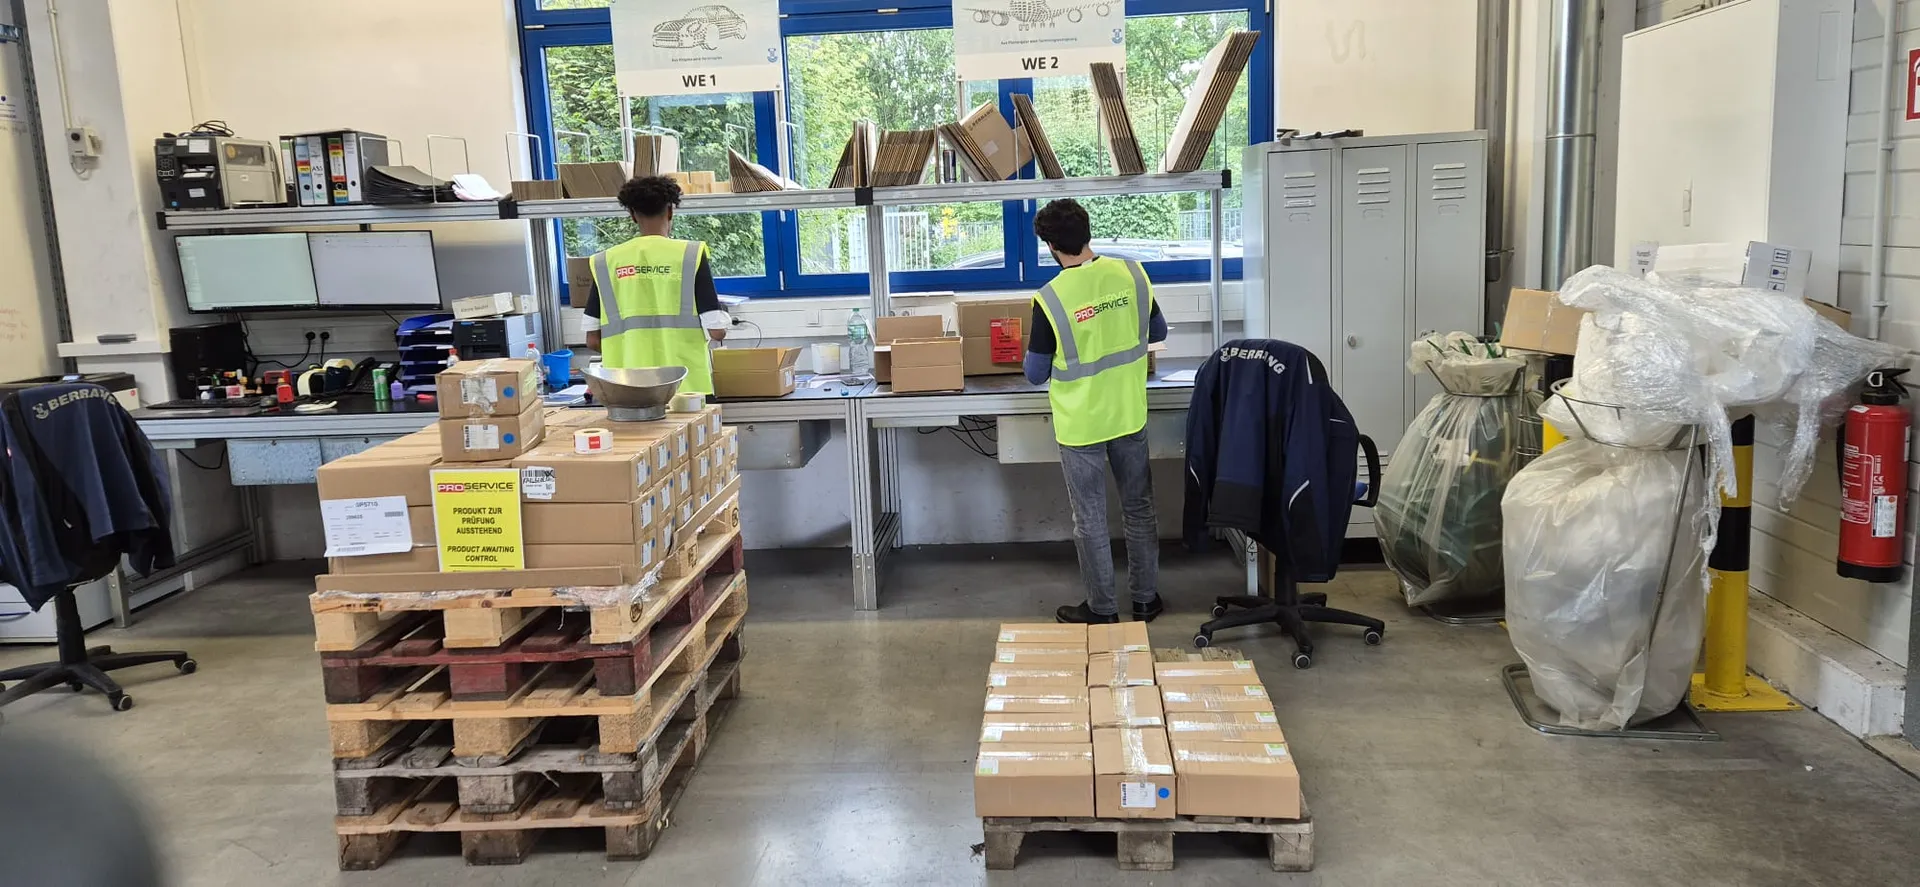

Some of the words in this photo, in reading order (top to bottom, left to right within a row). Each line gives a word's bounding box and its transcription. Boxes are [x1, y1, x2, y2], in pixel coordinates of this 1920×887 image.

[1021, 56, 1047, 71] WE
[1050, 56, 1059, 69] 2
[682, 74, 707, 88] WE
[709, 74, 717, 87] 1
[615, 265, 671, 278] PROSERVICE
[1074, 296, 1129, 323] PROSERVICE
[437, 482, 514, 492] PROSERVICE
[453, 507, 487, 515] PRODUKT
[488, 507, 503, 515] ZUR
[461, 516, 496, 525] PRÜFUNG
[456, 527, 503, 535] AUSSTEHEND
[447, 545, 480, 553] PRODUCT
[481, 545, 515, 553] AWAITING
